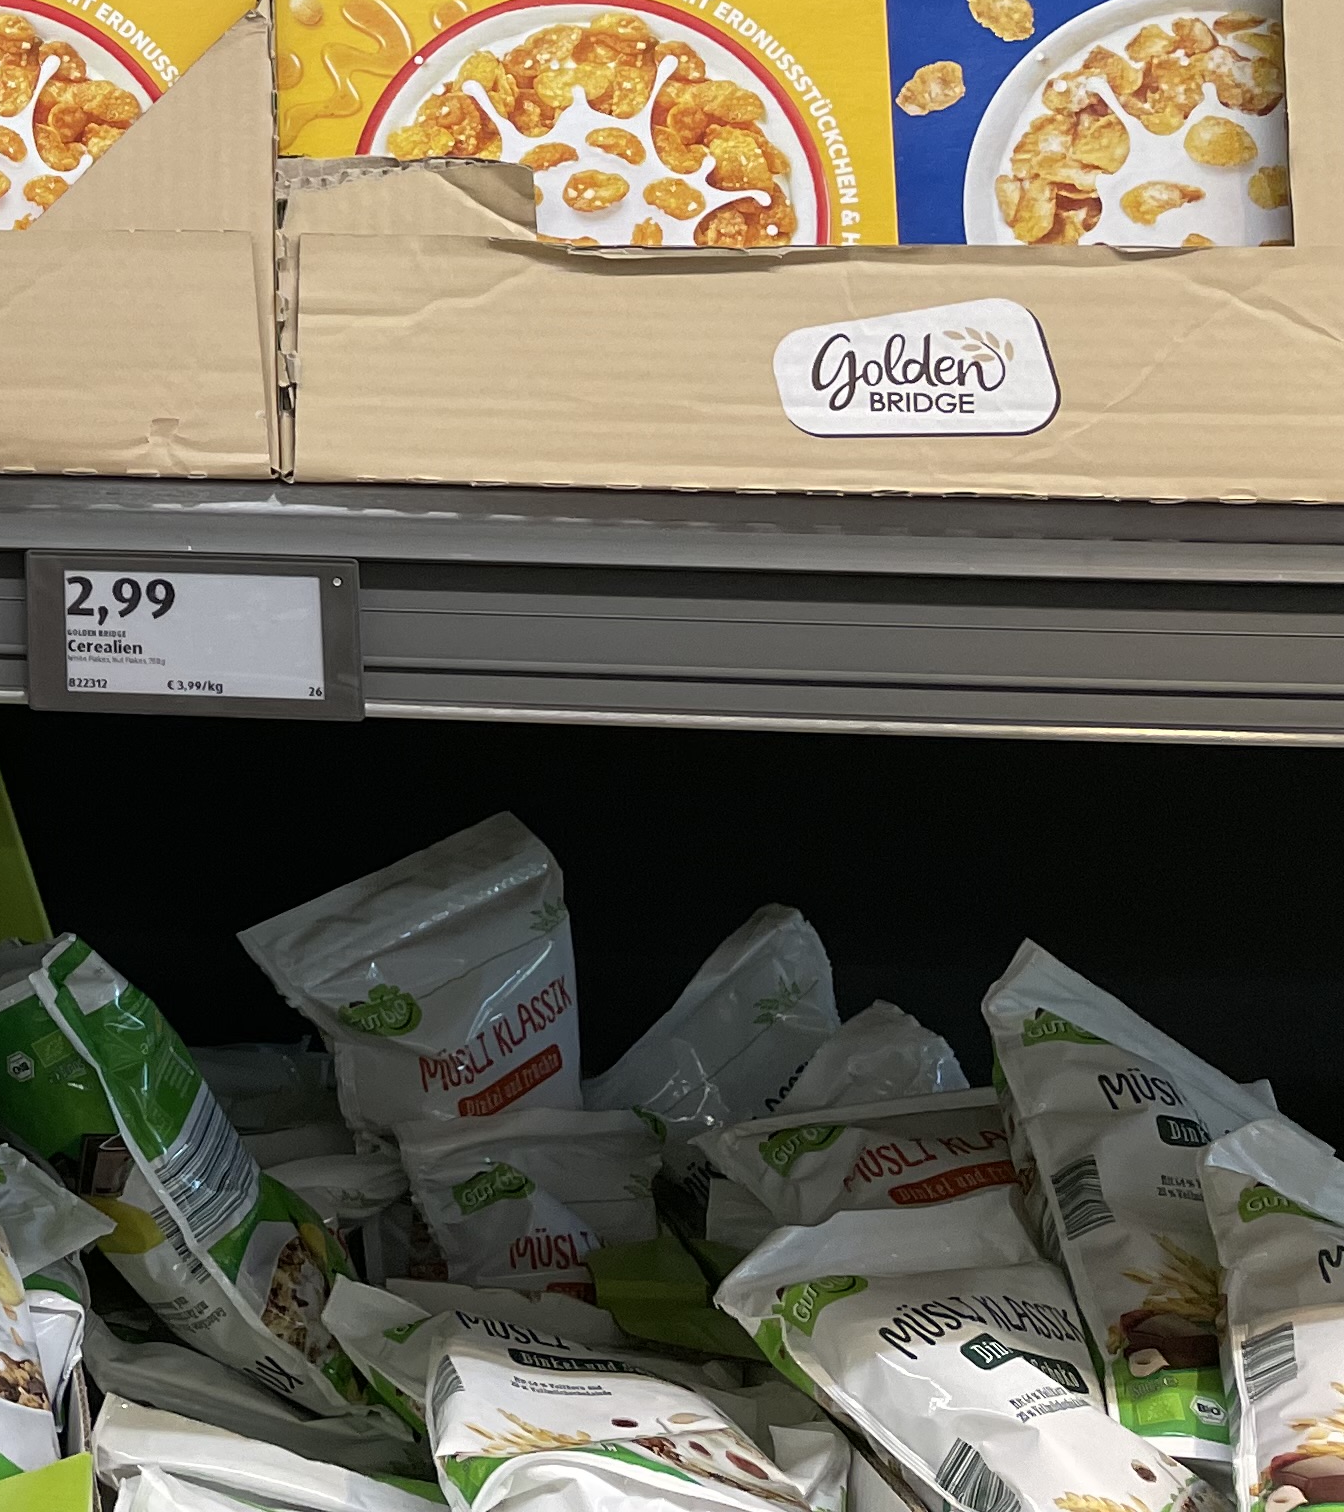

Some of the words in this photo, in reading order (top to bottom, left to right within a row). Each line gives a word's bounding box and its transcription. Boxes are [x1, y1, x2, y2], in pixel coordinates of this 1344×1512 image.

[713, 1, 860, 204] ERDNUSSSTÜCKCHEN
[841, 209, 861, 227] &
[811, 333, 1007, 411] Golden
[869, 393, 976, 413] BRIDGE
[67, 576, 175, 626] 2,99
[67, 629, 96, 637] GOLDEN
[98, 630, 126, 638] BRIDGE
[68, 640, 143, 655] Cerealien
[69, 678, 108, 689] 822312
[177, 680, 223, 694] 3,99/kg
[309, 687, 323, 697] 26
[419, 1033, 493, 1092] MÜSLI
[493, 975, 573, 1056] KLASSIK
